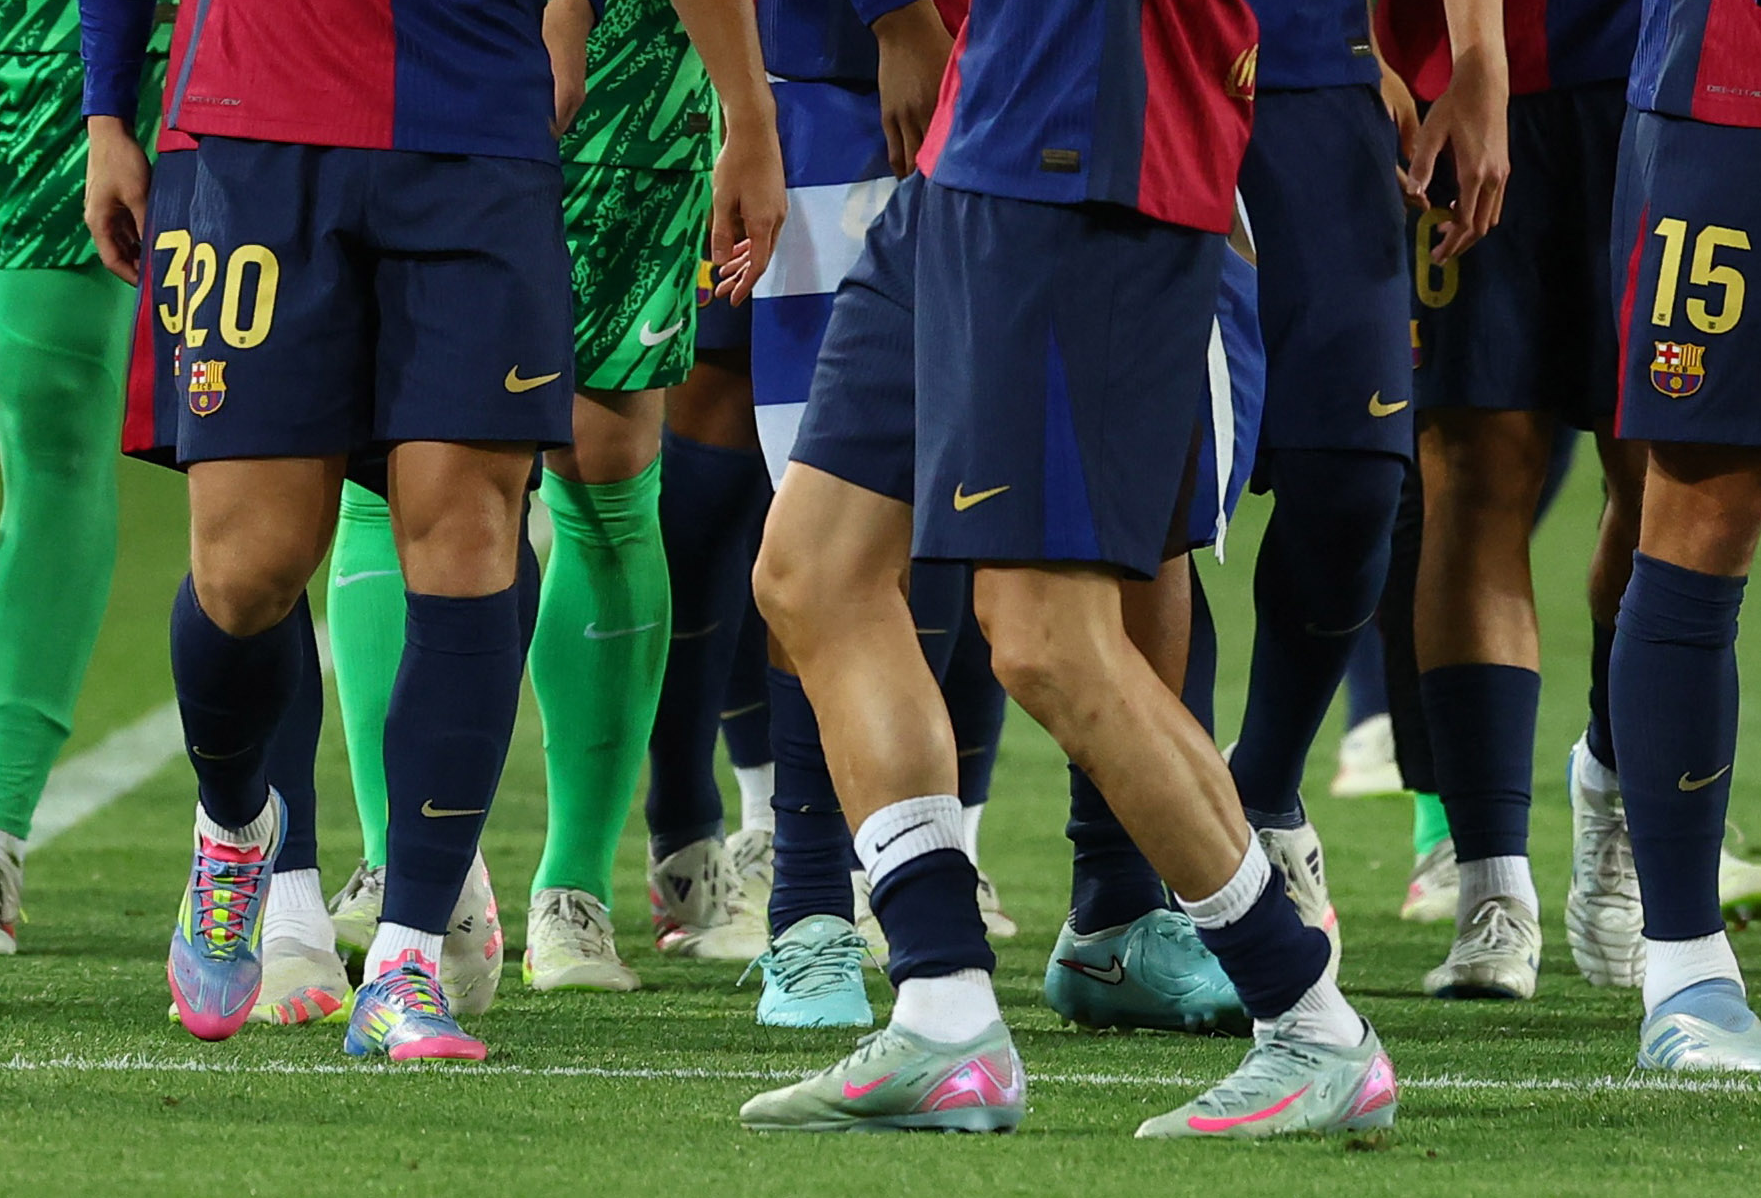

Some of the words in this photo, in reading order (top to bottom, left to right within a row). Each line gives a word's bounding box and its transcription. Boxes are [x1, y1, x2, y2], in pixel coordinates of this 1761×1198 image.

[185, 242, 279, 349] 20
[1652, 217, 1752, 334] 15
[197, 383, 212, 391] FCB
[1667, 363, 1688, 373] FCB
